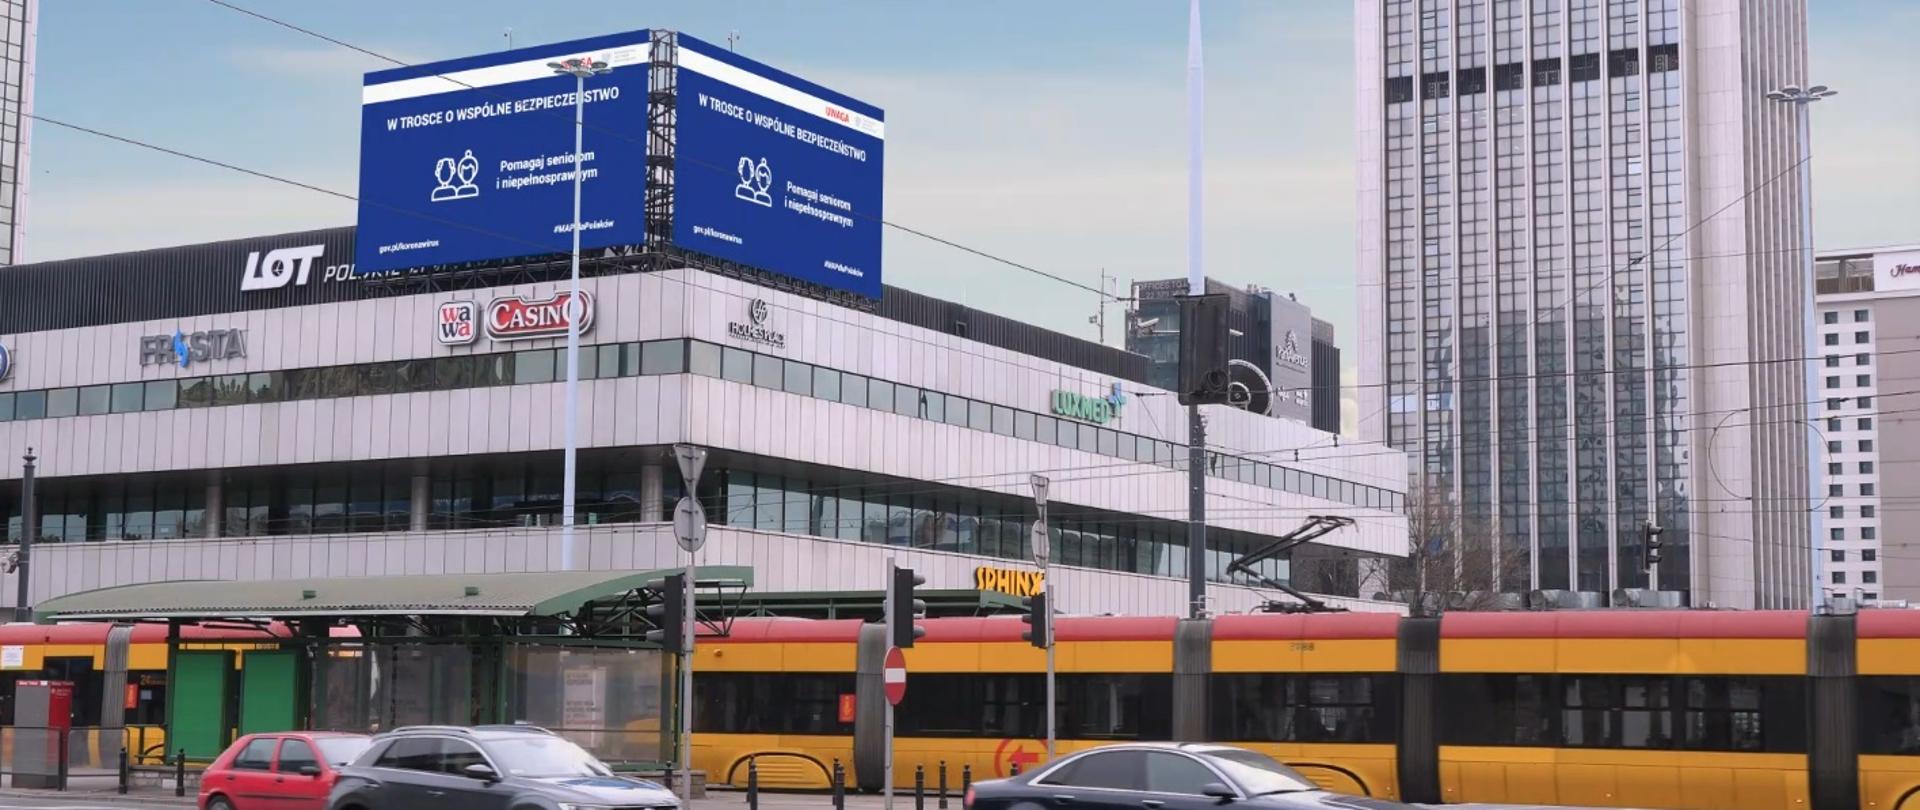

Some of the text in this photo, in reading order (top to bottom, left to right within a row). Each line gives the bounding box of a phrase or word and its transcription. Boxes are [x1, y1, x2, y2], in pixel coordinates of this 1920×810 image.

[387, 86, 620, 131] W TROSCE O WSPÓLNE BEZPIECZESTWO
[825, 106, 850, 124] UWAGA
[699, 92, 866, 162] W TROSCE O WSPÓLNE BEZPIECZEŃSTWO
[500, 155, 545, 173] Pomagaj
[787, 181, 851, 212] Pomagaj seniorom
[379, 239, 439, 255] gov.pl/koronawirus
[241, 244, 325, 291] LOT
[1051, 390, 1109, 424] LUXMED
[975, 566, 1045, 597] SPHINX
